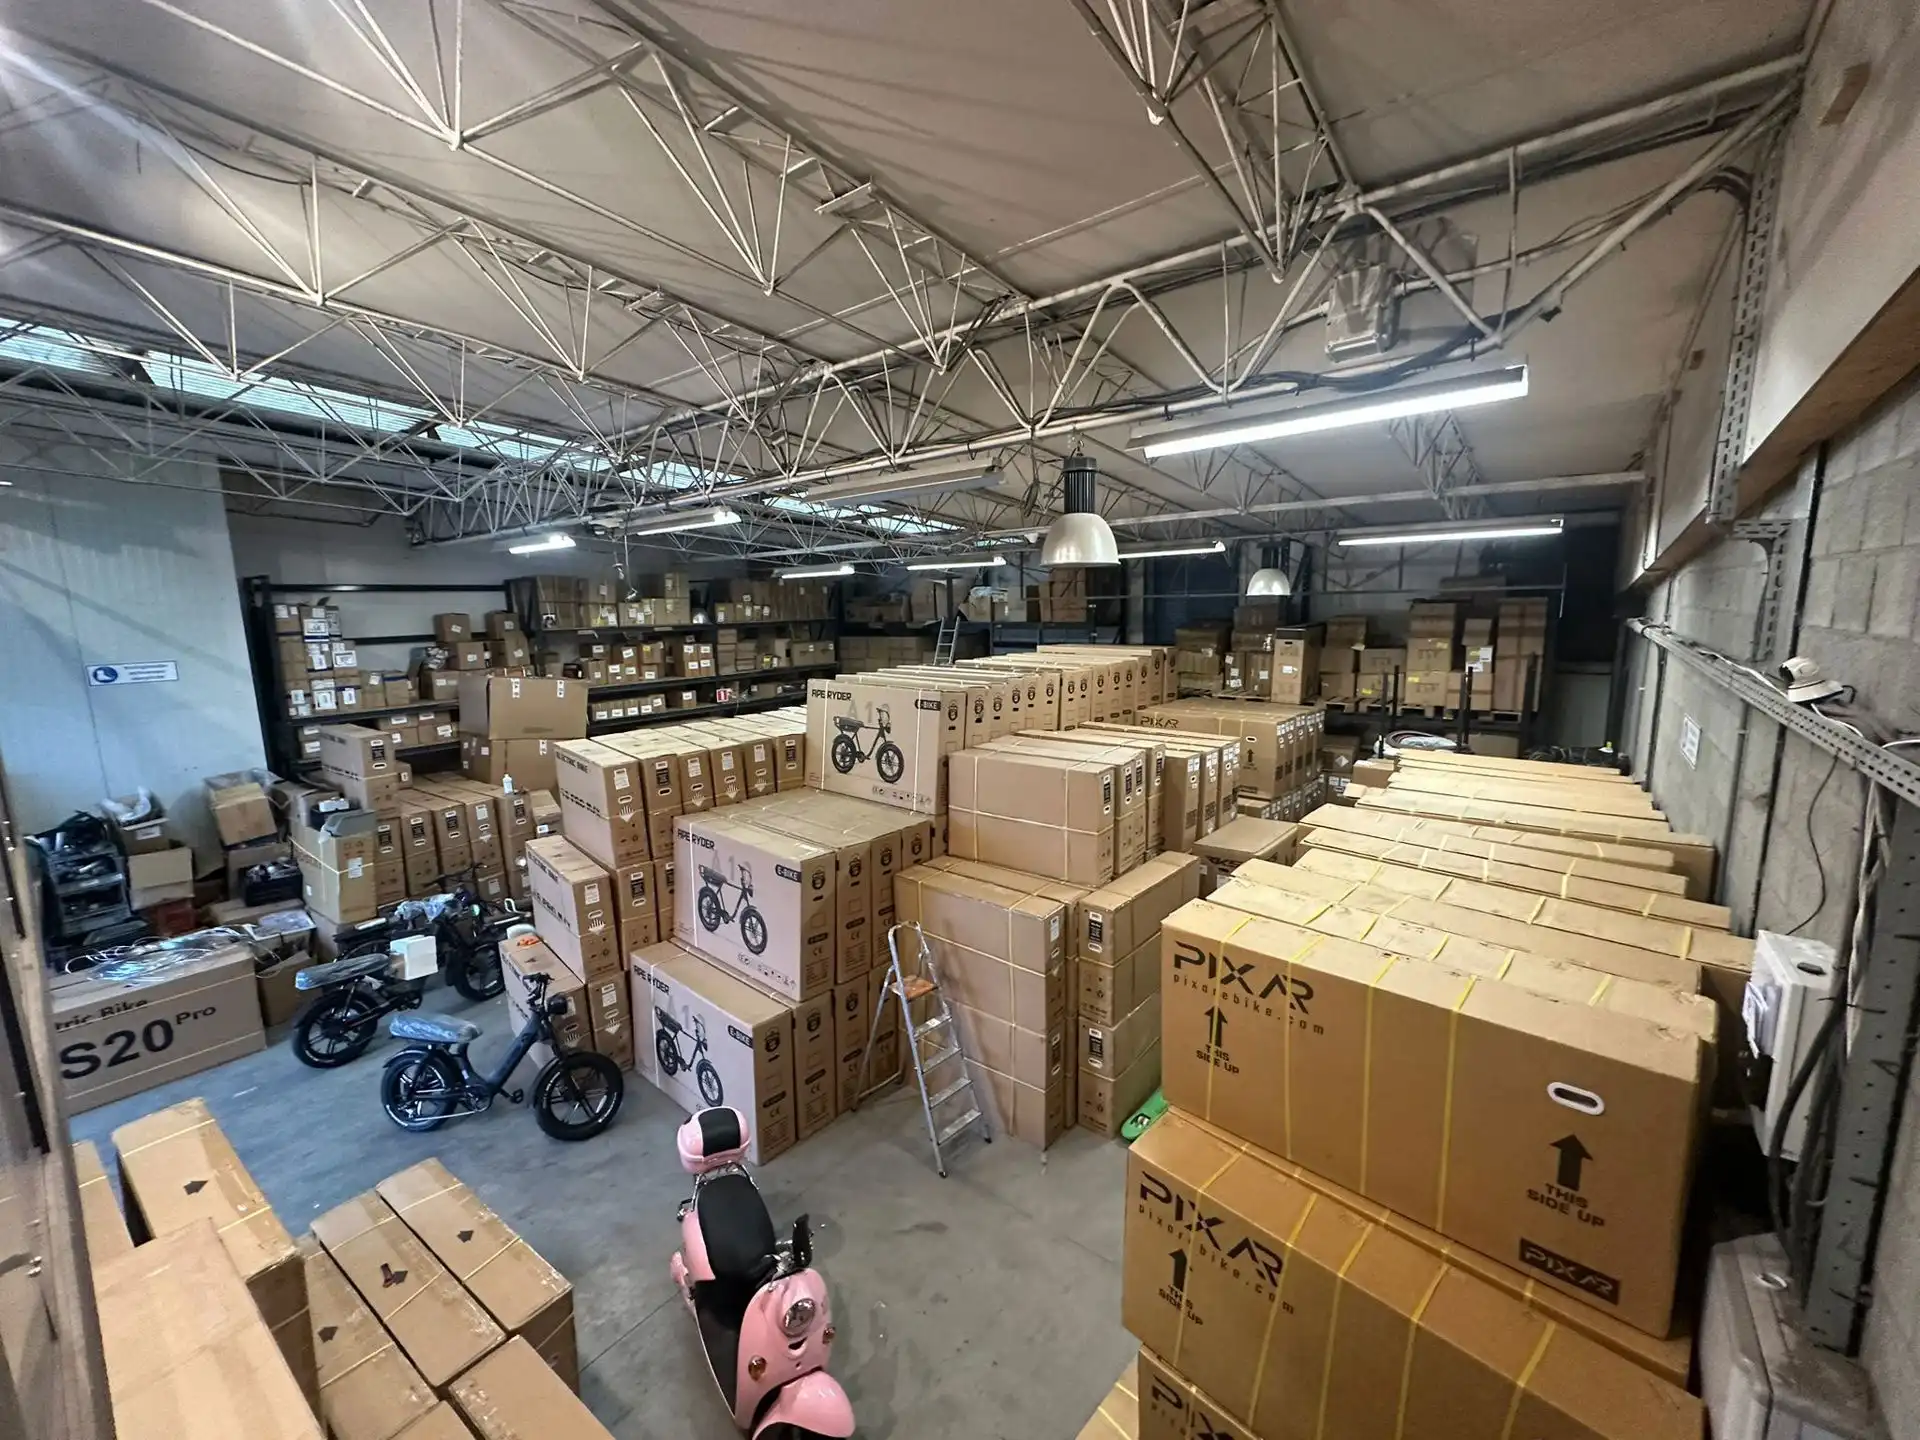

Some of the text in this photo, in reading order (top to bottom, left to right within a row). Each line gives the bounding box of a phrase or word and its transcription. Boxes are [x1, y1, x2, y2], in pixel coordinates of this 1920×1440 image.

[827, 689, 852, 701] RYDER
[691, 833, 715, 850] RYDER
[777, 865, 799, 880] E-BIKE
[1174, 940, 1314, 1015] PIXAR
[60, 1006, 216, 1080] S20 Pro
[1224, 1062, 1240, 1074] UP
[1526, 1188, 1605, 1227] SIDE UP
[1545, 1183, 1588, 1209] THIS
[1140, 1170, 1283, 1288] PIXAR
[1139, 1204, 1294, 1315] pixarbike.com
[1523, 1246, 1614, 1296] PIXAR
[1167, 1284, 1193, 1310] THS
